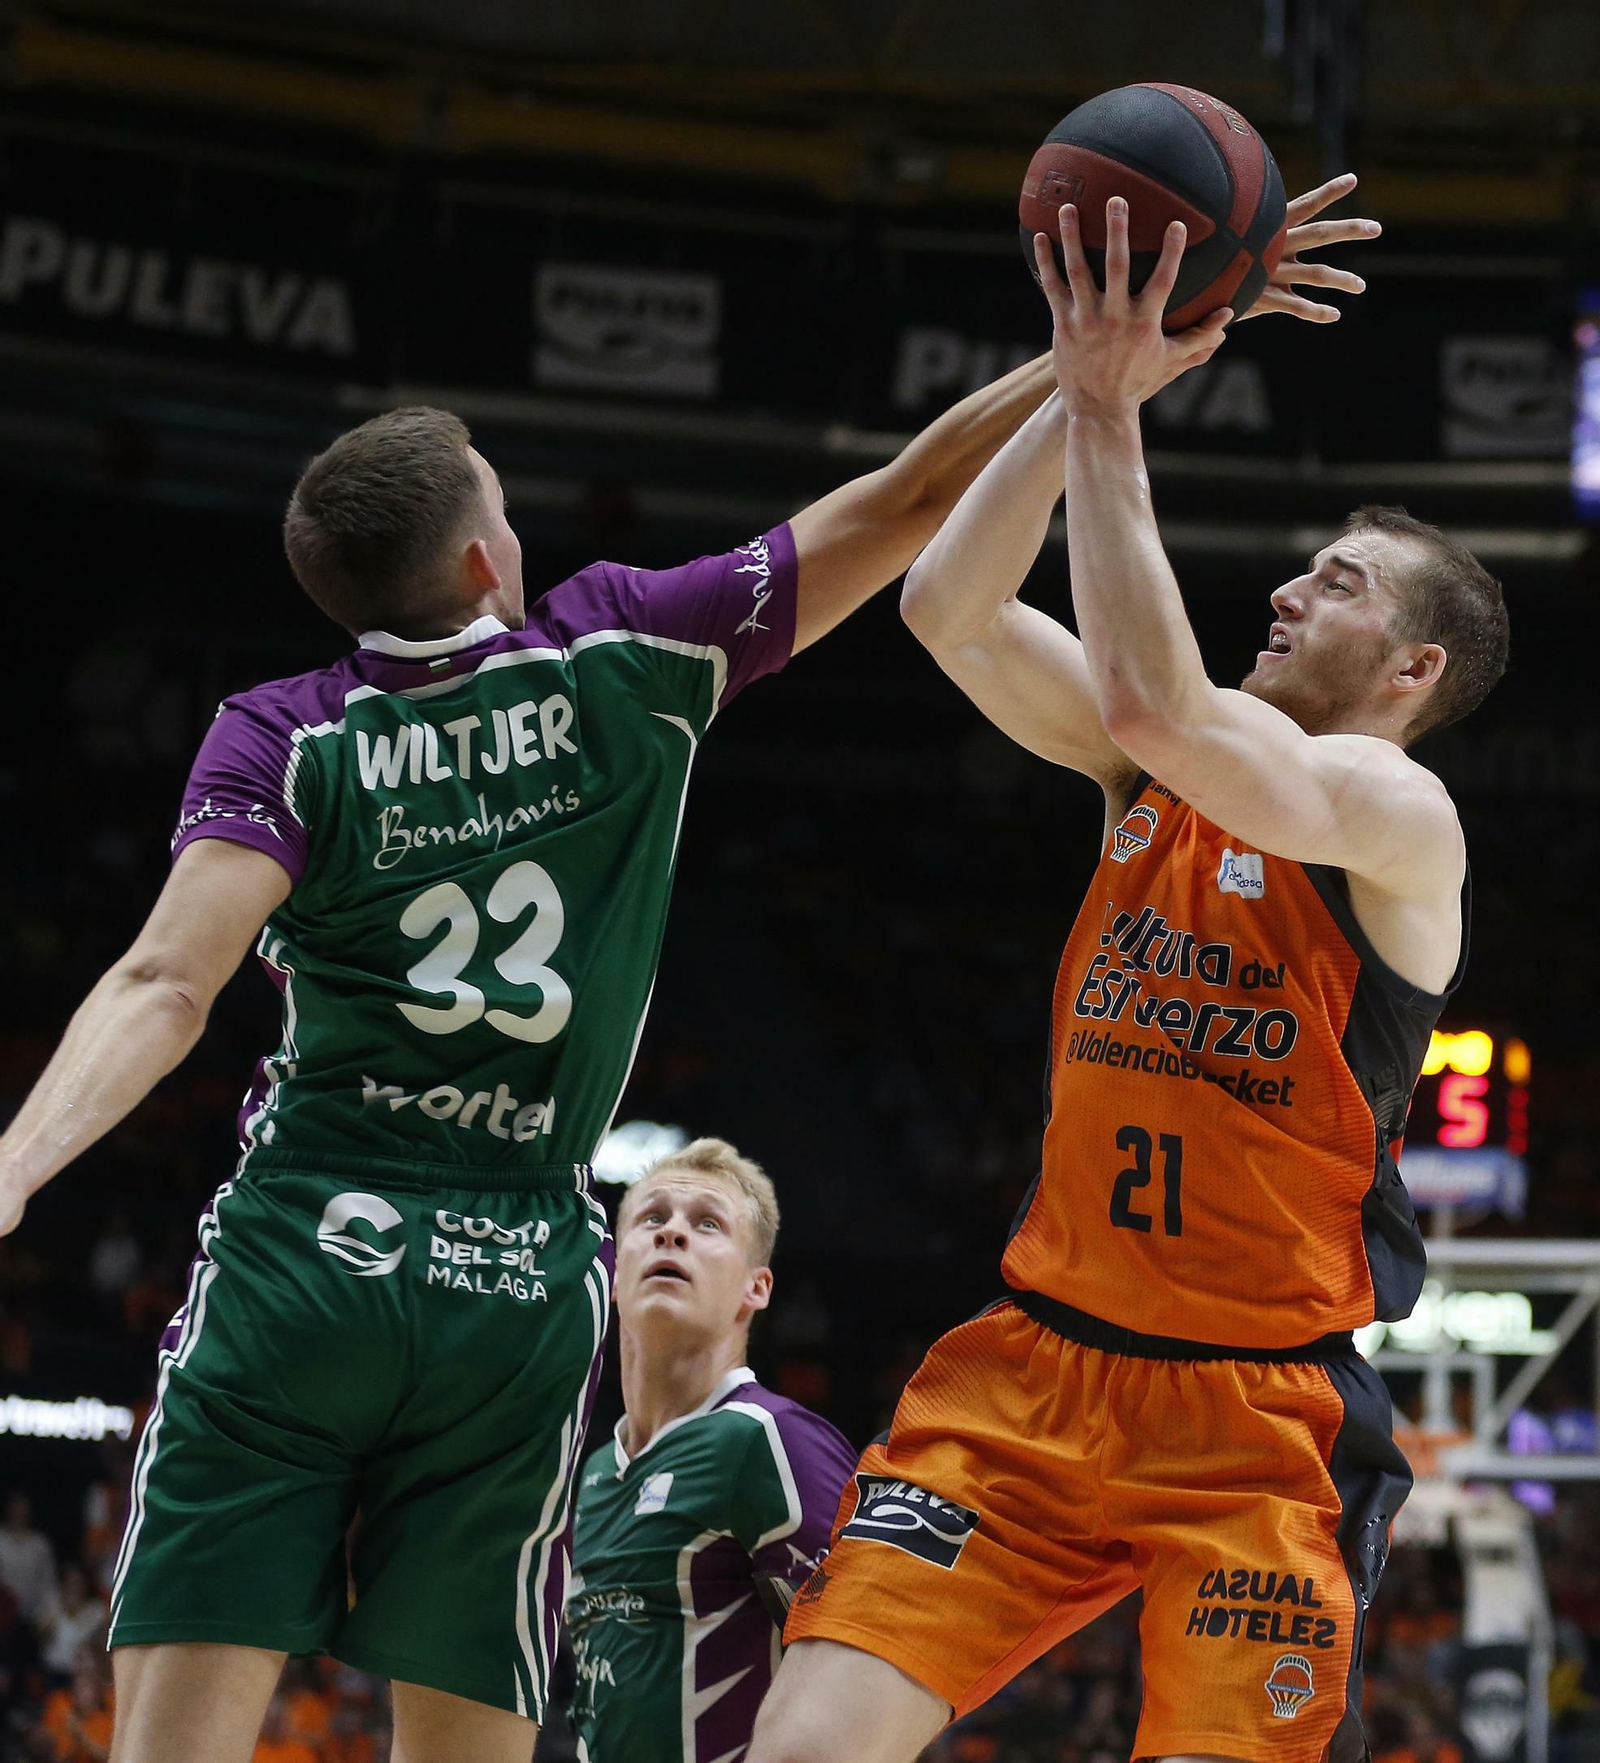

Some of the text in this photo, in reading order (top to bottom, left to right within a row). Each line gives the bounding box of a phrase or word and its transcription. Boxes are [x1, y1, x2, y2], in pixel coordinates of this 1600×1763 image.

[0, 219, 356, 358] PULEVA
[355, 693, 579, 791] WILTJER
[395, 860, 573, 1043] 33
[1239, 959, 1286, 990] del
[1437, 1073, 1490, 1148] 5
[1109, 1125, 1183, 1237] 21
[430, 1234, 546, 1276] DEL SOL
[435, 1208, 551, 1247] COSTA
[426, 1264, 548, 1302] MÁLAGA
